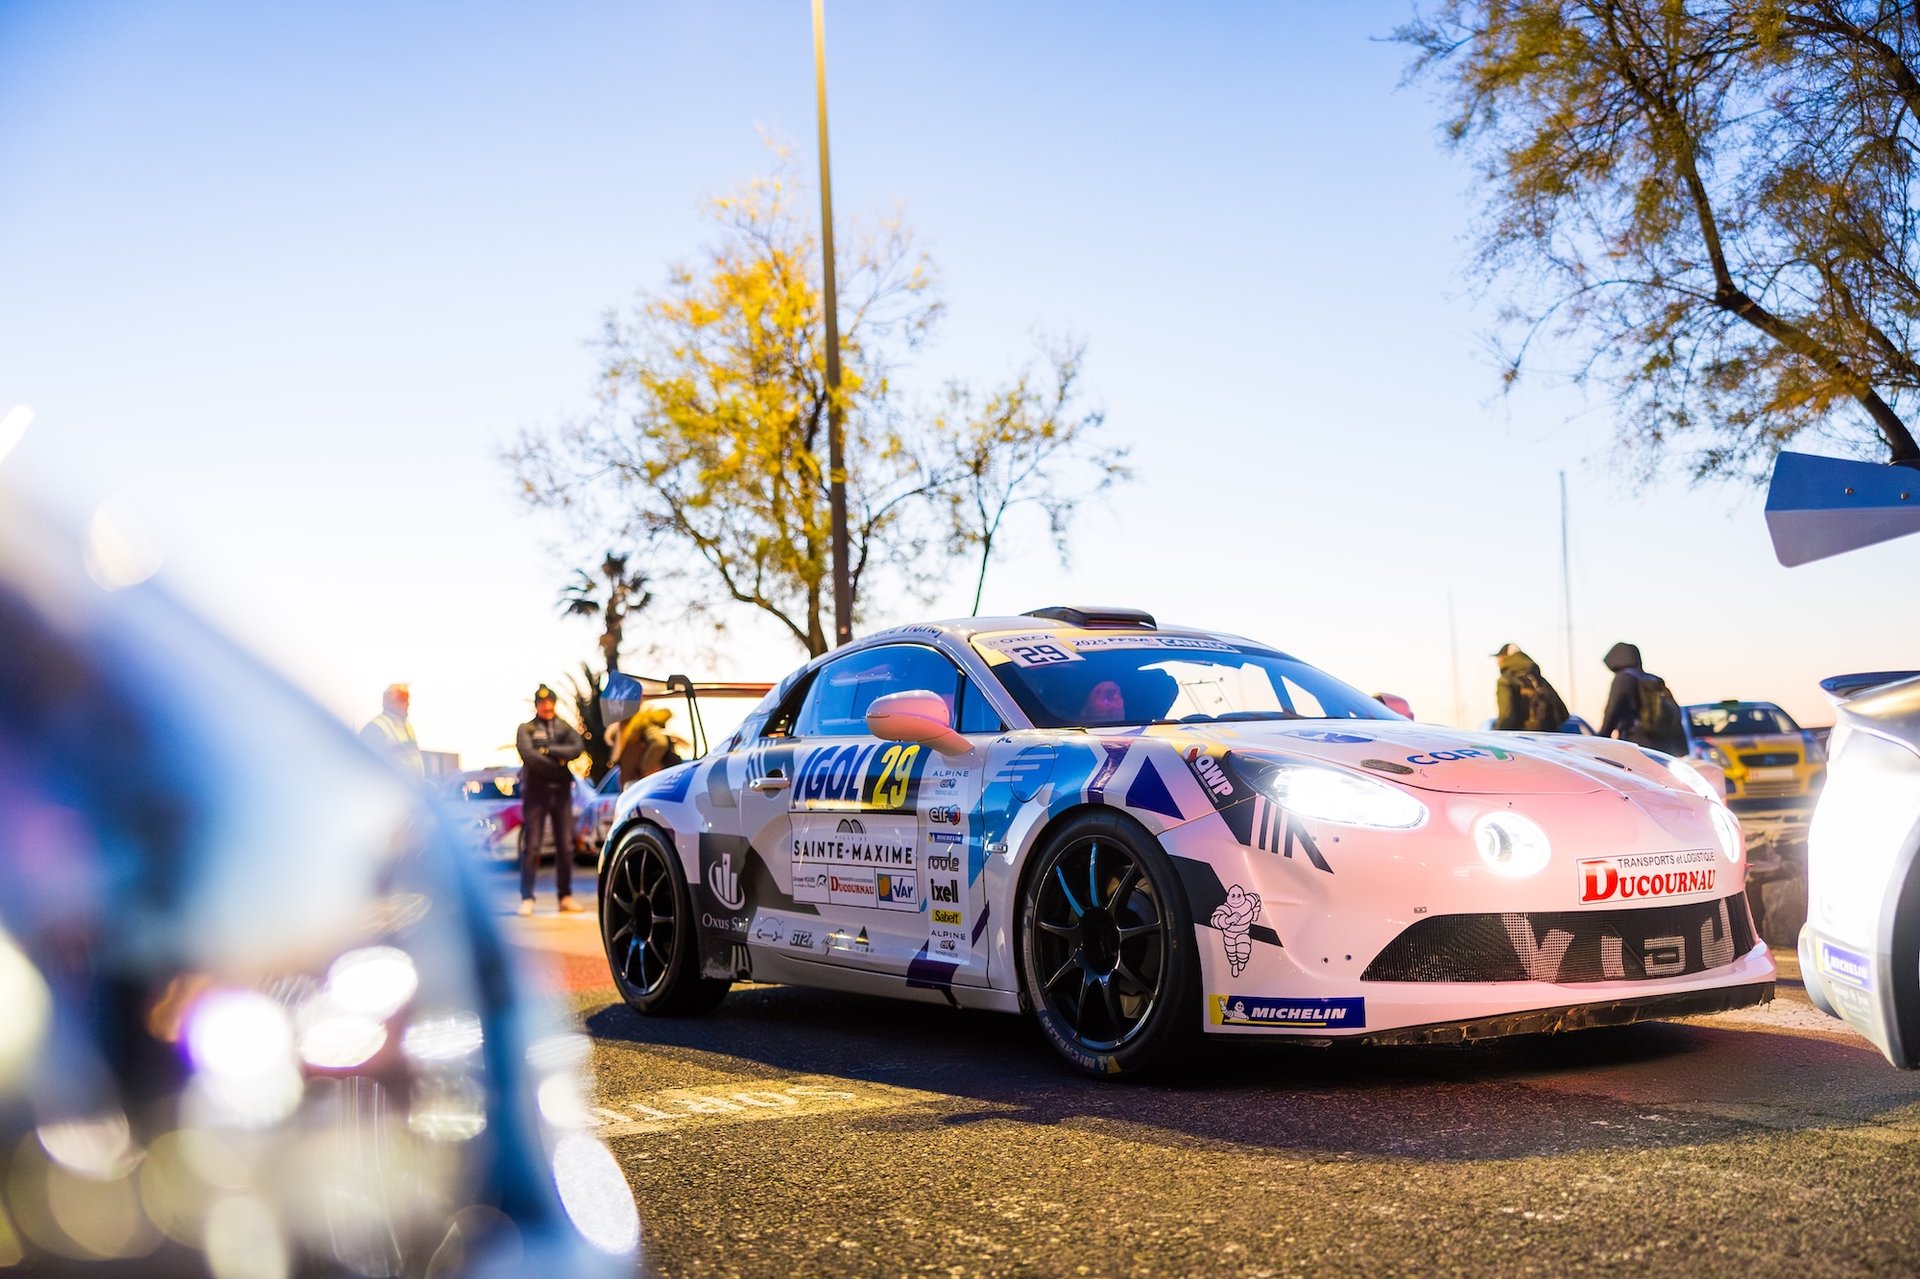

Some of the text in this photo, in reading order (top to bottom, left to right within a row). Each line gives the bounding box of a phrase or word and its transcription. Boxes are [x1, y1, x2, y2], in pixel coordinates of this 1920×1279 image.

[1012, 644, 1070, 664] 29
[793, 744, 876, 802] IGOL
[872, 744, 921, 808] 29
[932, 770, 970, 778] ALPINE
[929, 806, 950, 823] elf
[794, 839, 913, 865] SAINTE-MAXIME
[1617, 851, 1715, 868] TRANSPORTS et LOGISTIQUE
[930, 878, 959, 903] ixell
[702, 913, 729, 930] Oxus
[935, 909, 959, 925] Sabelt
[931, 929, 966, 940] ALPINE
[1251, 1007, 1347, 1020] MICHELIN
[582, 1085, 857, 1126] SORTI
